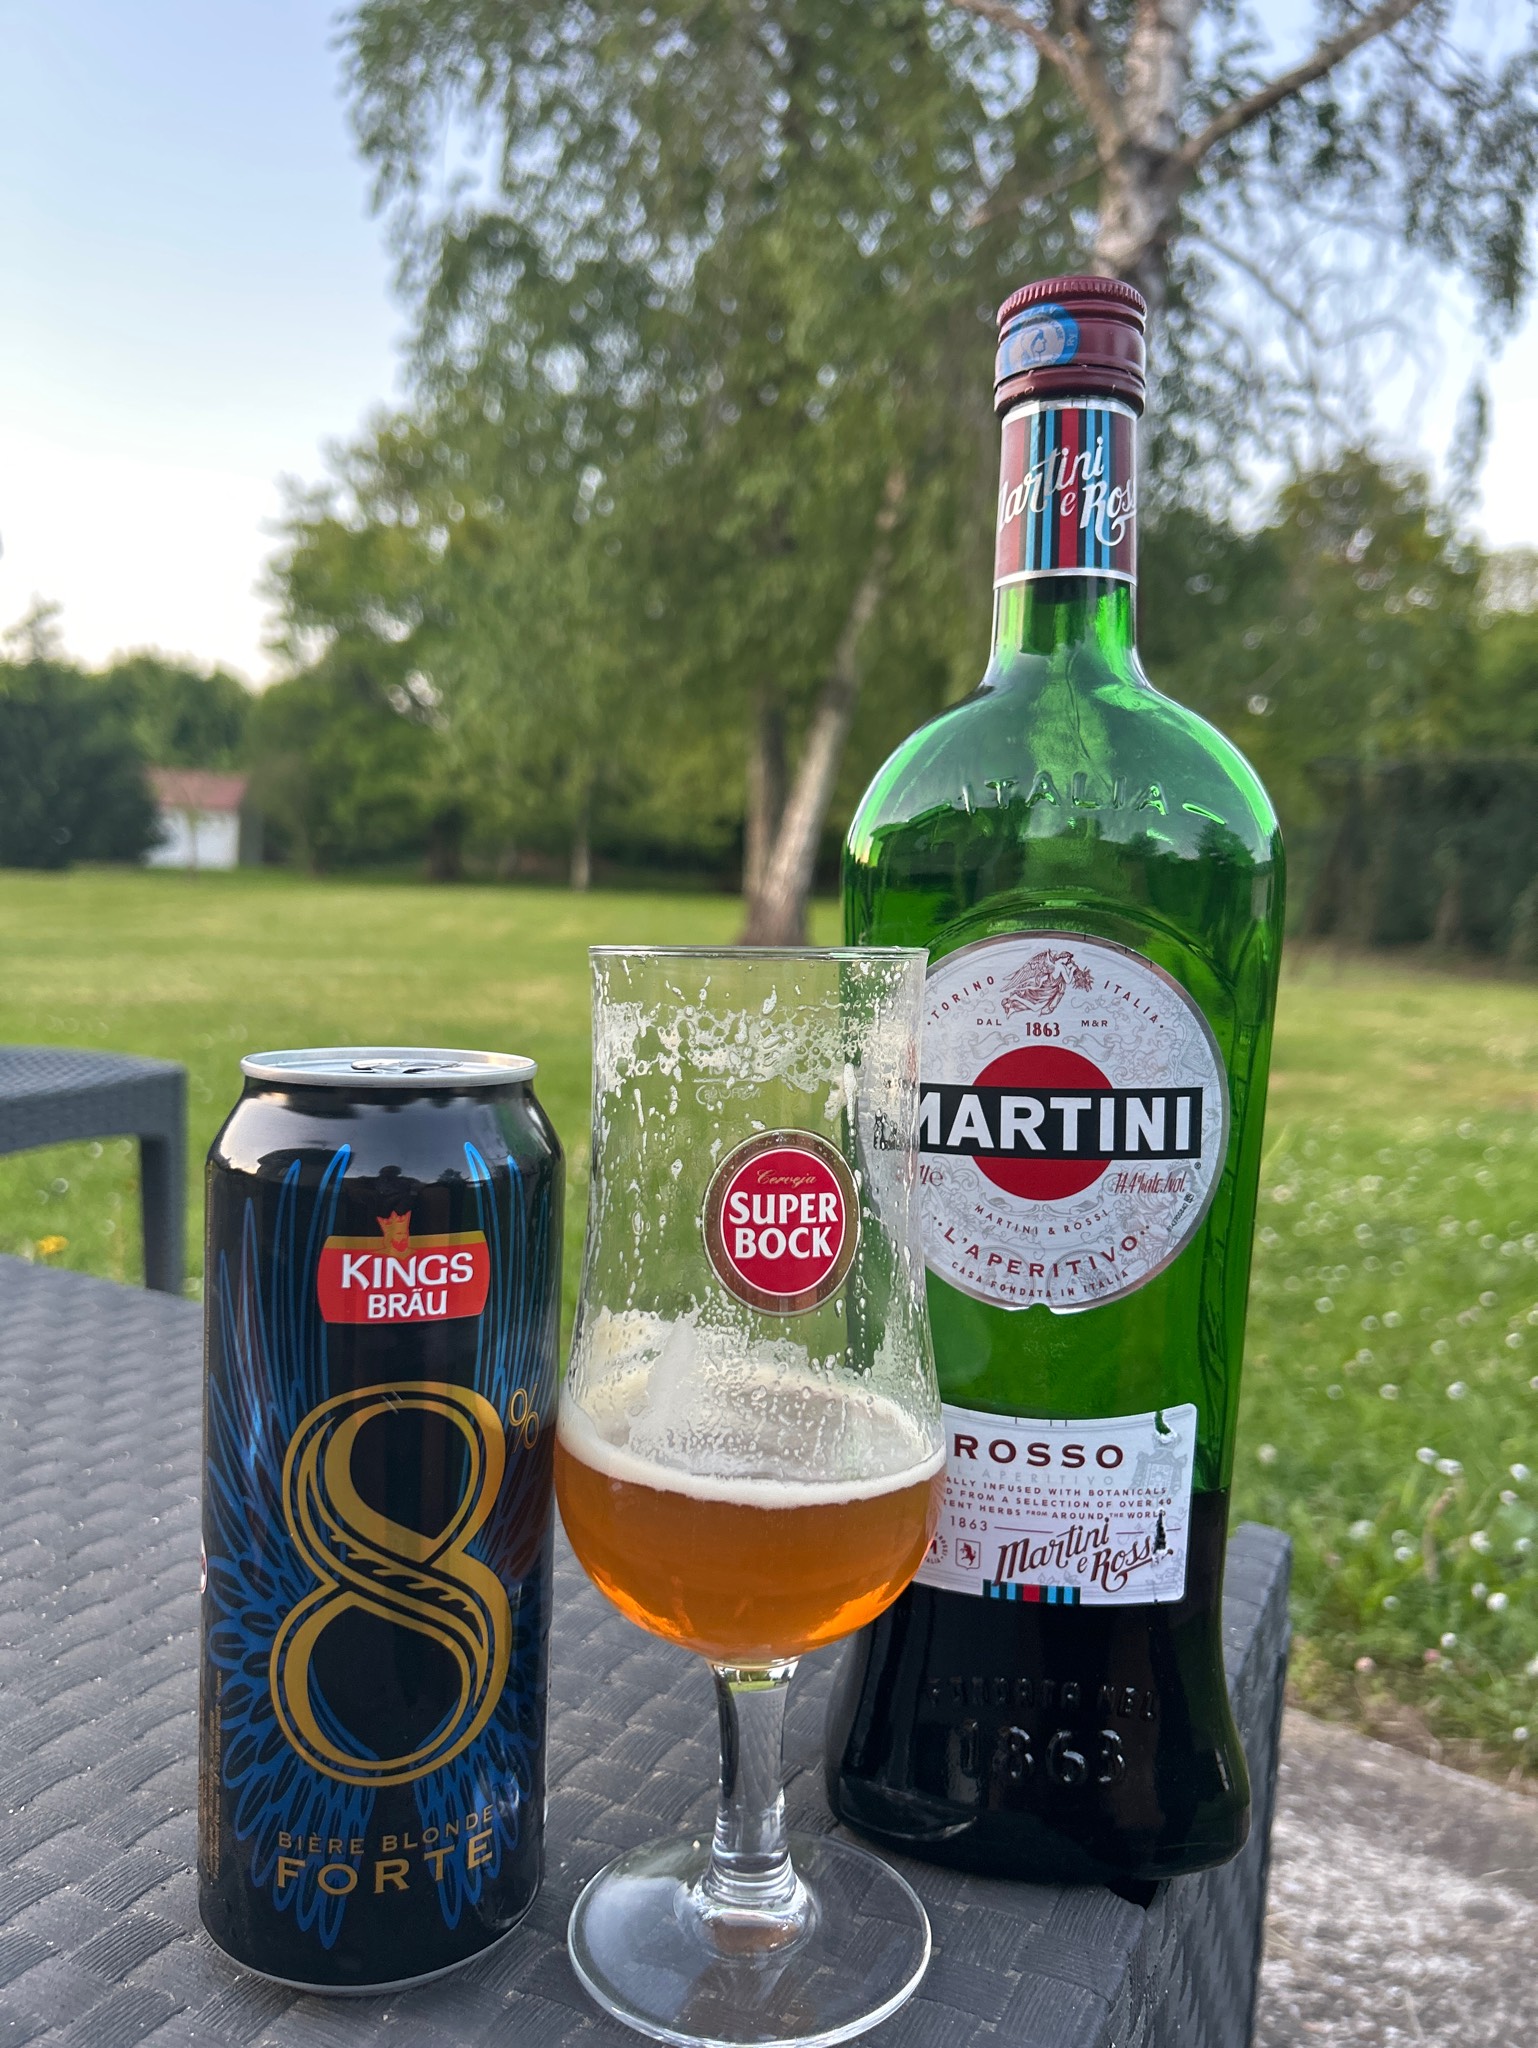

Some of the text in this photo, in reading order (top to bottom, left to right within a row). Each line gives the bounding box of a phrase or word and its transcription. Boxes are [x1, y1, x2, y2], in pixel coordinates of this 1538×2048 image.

[1061, 492, 1076, 517] e
[960, 770, 1168, 816] ITALIA
[931, 976, 1159, 1023] TORINO ITALIA
[976, 1018, 1002, 1026] DAL
[1026, 1022, 1060, 1037] 1863
[757, 1169, 817, 1189] Cerveja
[729, 1191, 839, 1225] SUPER
[975, 1204, 1109, 1235] MARTINI & ROSSI
[735, 1227, 834, 1259] BOCK
[944, 1226, 1138, 1278] L'APERITIVO
[341, 1252, 474, 1290] KINGS
[952, 1261, 1129, 1298] CASA FONDATA IN ITALIA
[367, 1288, 448, 1319] BRÄU
[954, 1433, 1123, 1468] ROSSO
[960, 1490, 995, 1501] FROM
[1016, 1497, 1090, 1508] SELECTION
[1119, 1499, 1152, 1508] OVER
[983, 1482, 1041, 1494] INFUSED
[1049, 1488, 1081, 1496] WITH
[1088, 1487, 1168, 1497] BOTANICALS
[950, 1515, 987, 1531] 1863
[979, 1504, 1021, 1516] HERBS
[1052, 1511, 1104, 1520] AROUND
[993, 1517, 1109, 1586] Martini
[1077, 1536, 1171, 1593] e Ross
[269, 1380, 512, 1786] 8
[960, 1720, 1127, 1784] 1863
[278, 1804, 494, 1855] BIÈRE BLONDE
[277, 1828, 493, 1895] FORTE
